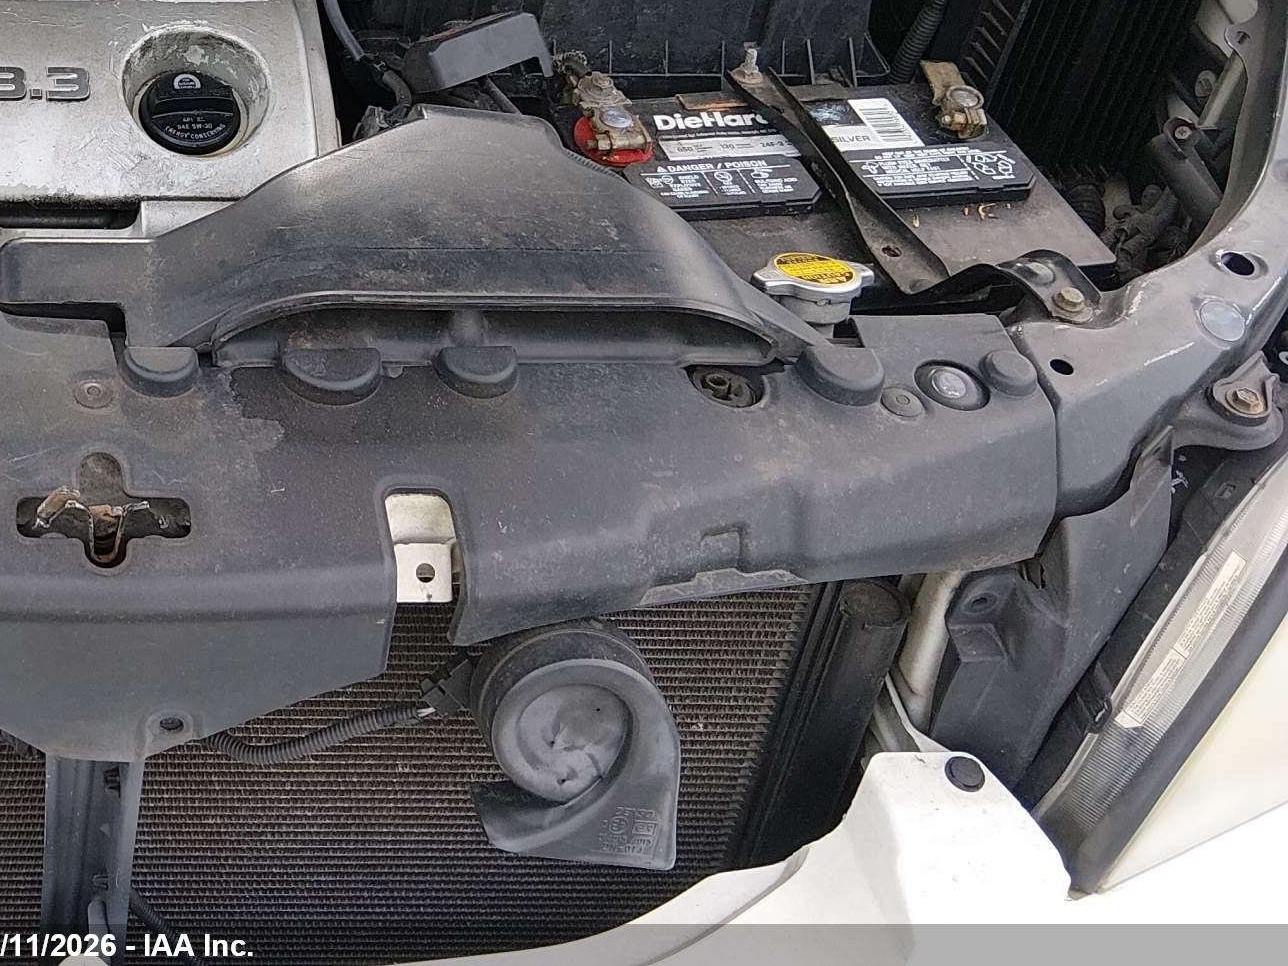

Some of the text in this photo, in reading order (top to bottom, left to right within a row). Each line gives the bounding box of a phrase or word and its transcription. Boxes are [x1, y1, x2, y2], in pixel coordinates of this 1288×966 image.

[831, 135, 871, 143] SILVER
[667, 163, 714, 173] DANGER
[725, 160, 768, 169] POISON
